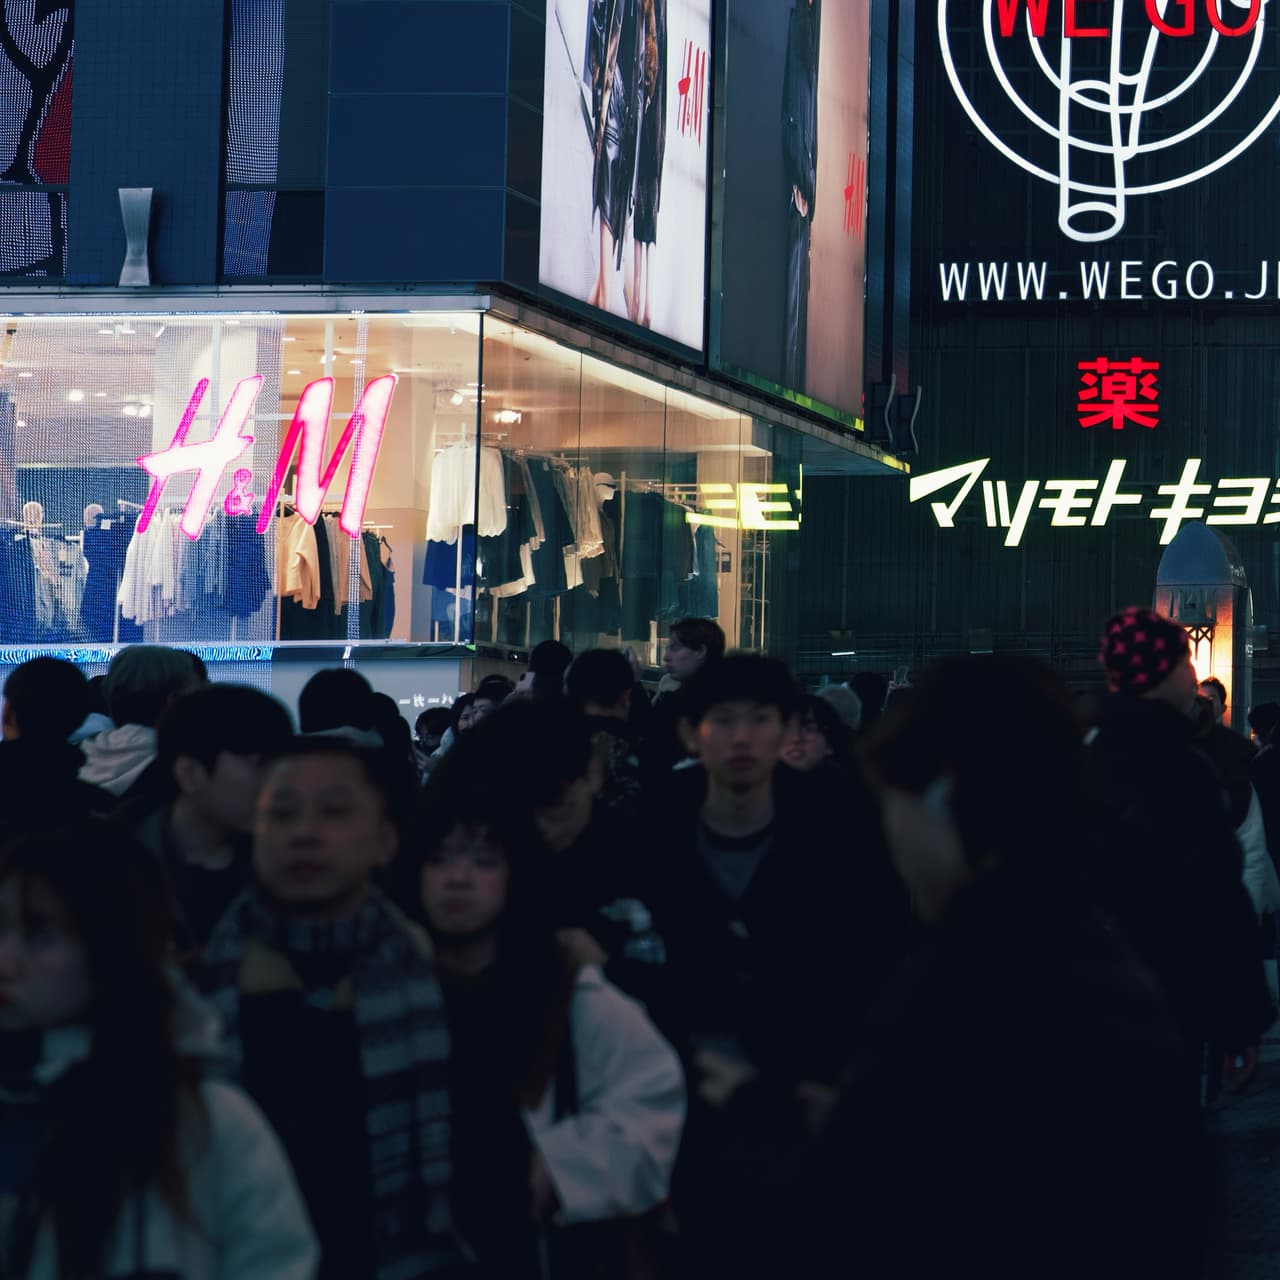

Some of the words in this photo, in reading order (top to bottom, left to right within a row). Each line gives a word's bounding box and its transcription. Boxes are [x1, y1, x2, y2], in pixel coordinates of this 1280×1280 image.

[677, 37, 707, 145] H&M
[1077, 357, 1161, 431] 薬
[137, 373, 400, 540] H&M
